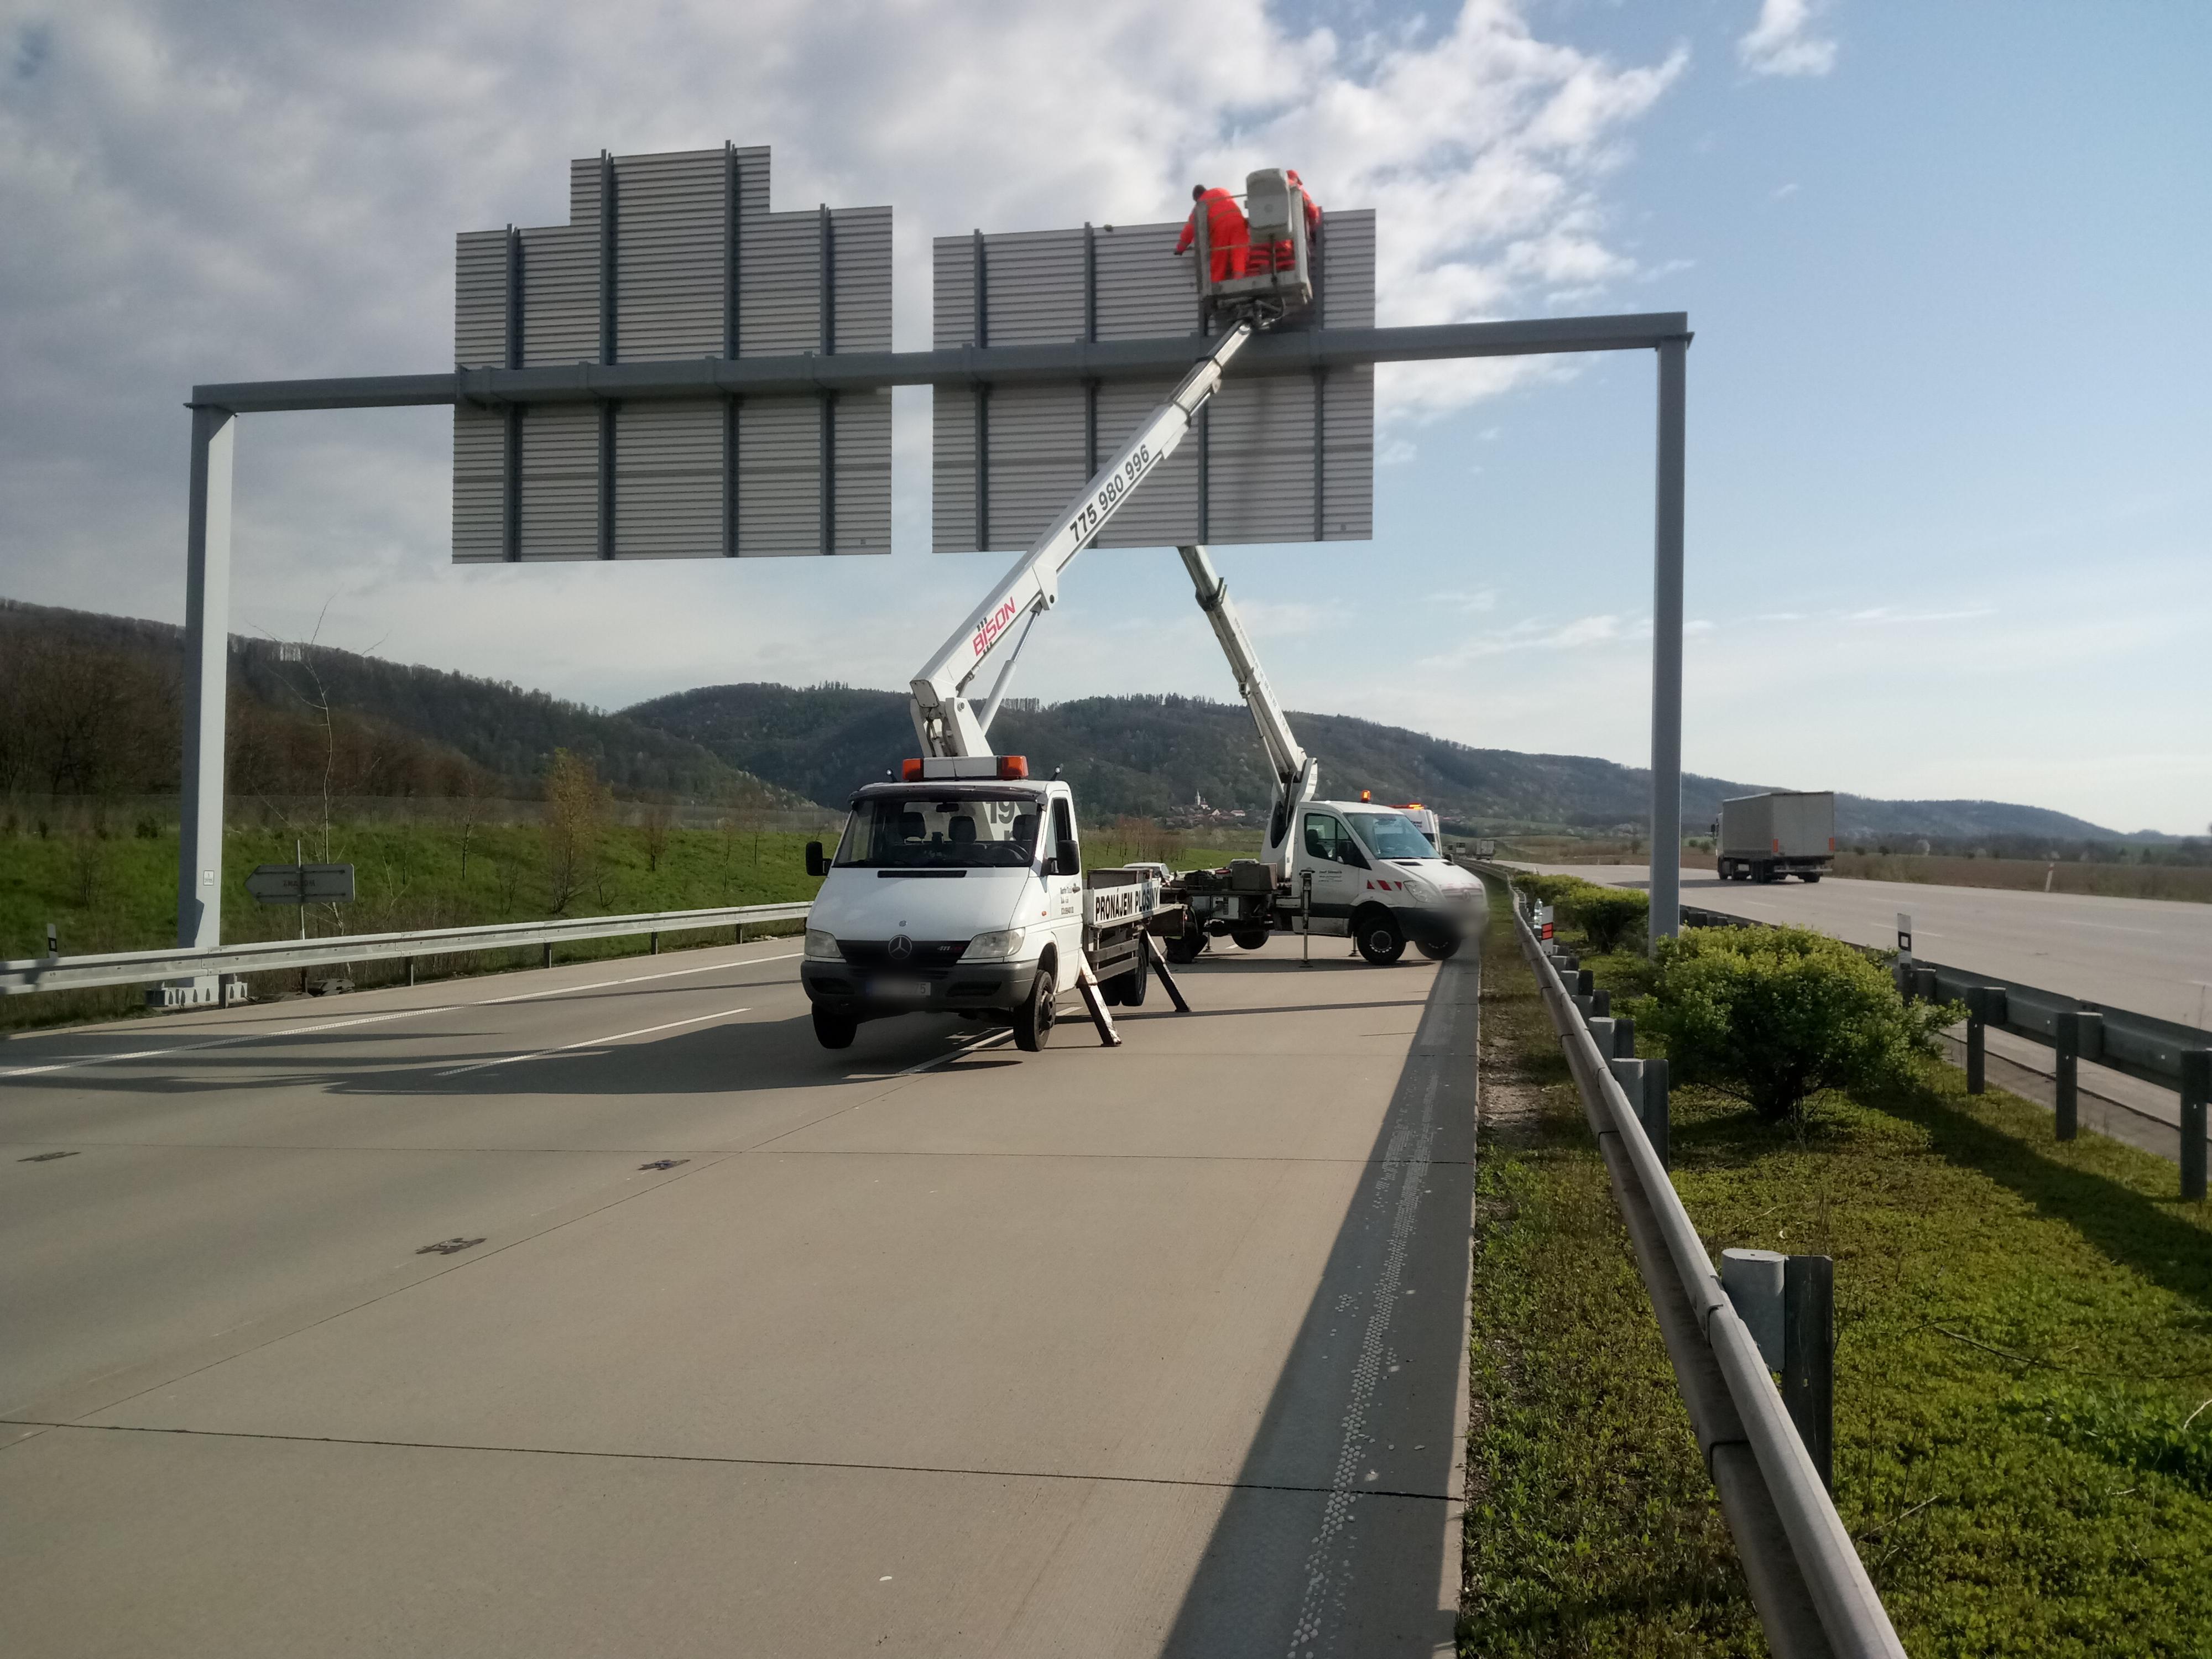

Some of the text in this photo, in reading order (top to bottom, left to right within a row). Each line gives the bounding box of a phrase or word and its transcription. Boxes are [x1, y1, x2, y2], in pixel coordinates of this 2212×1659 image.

[1070, 444, 1149, 542] 775 980 996
[973, 596, 1015, 656] BISON
[1095, 883, 1159, 921] PRONÁJEM PLOŠINY
